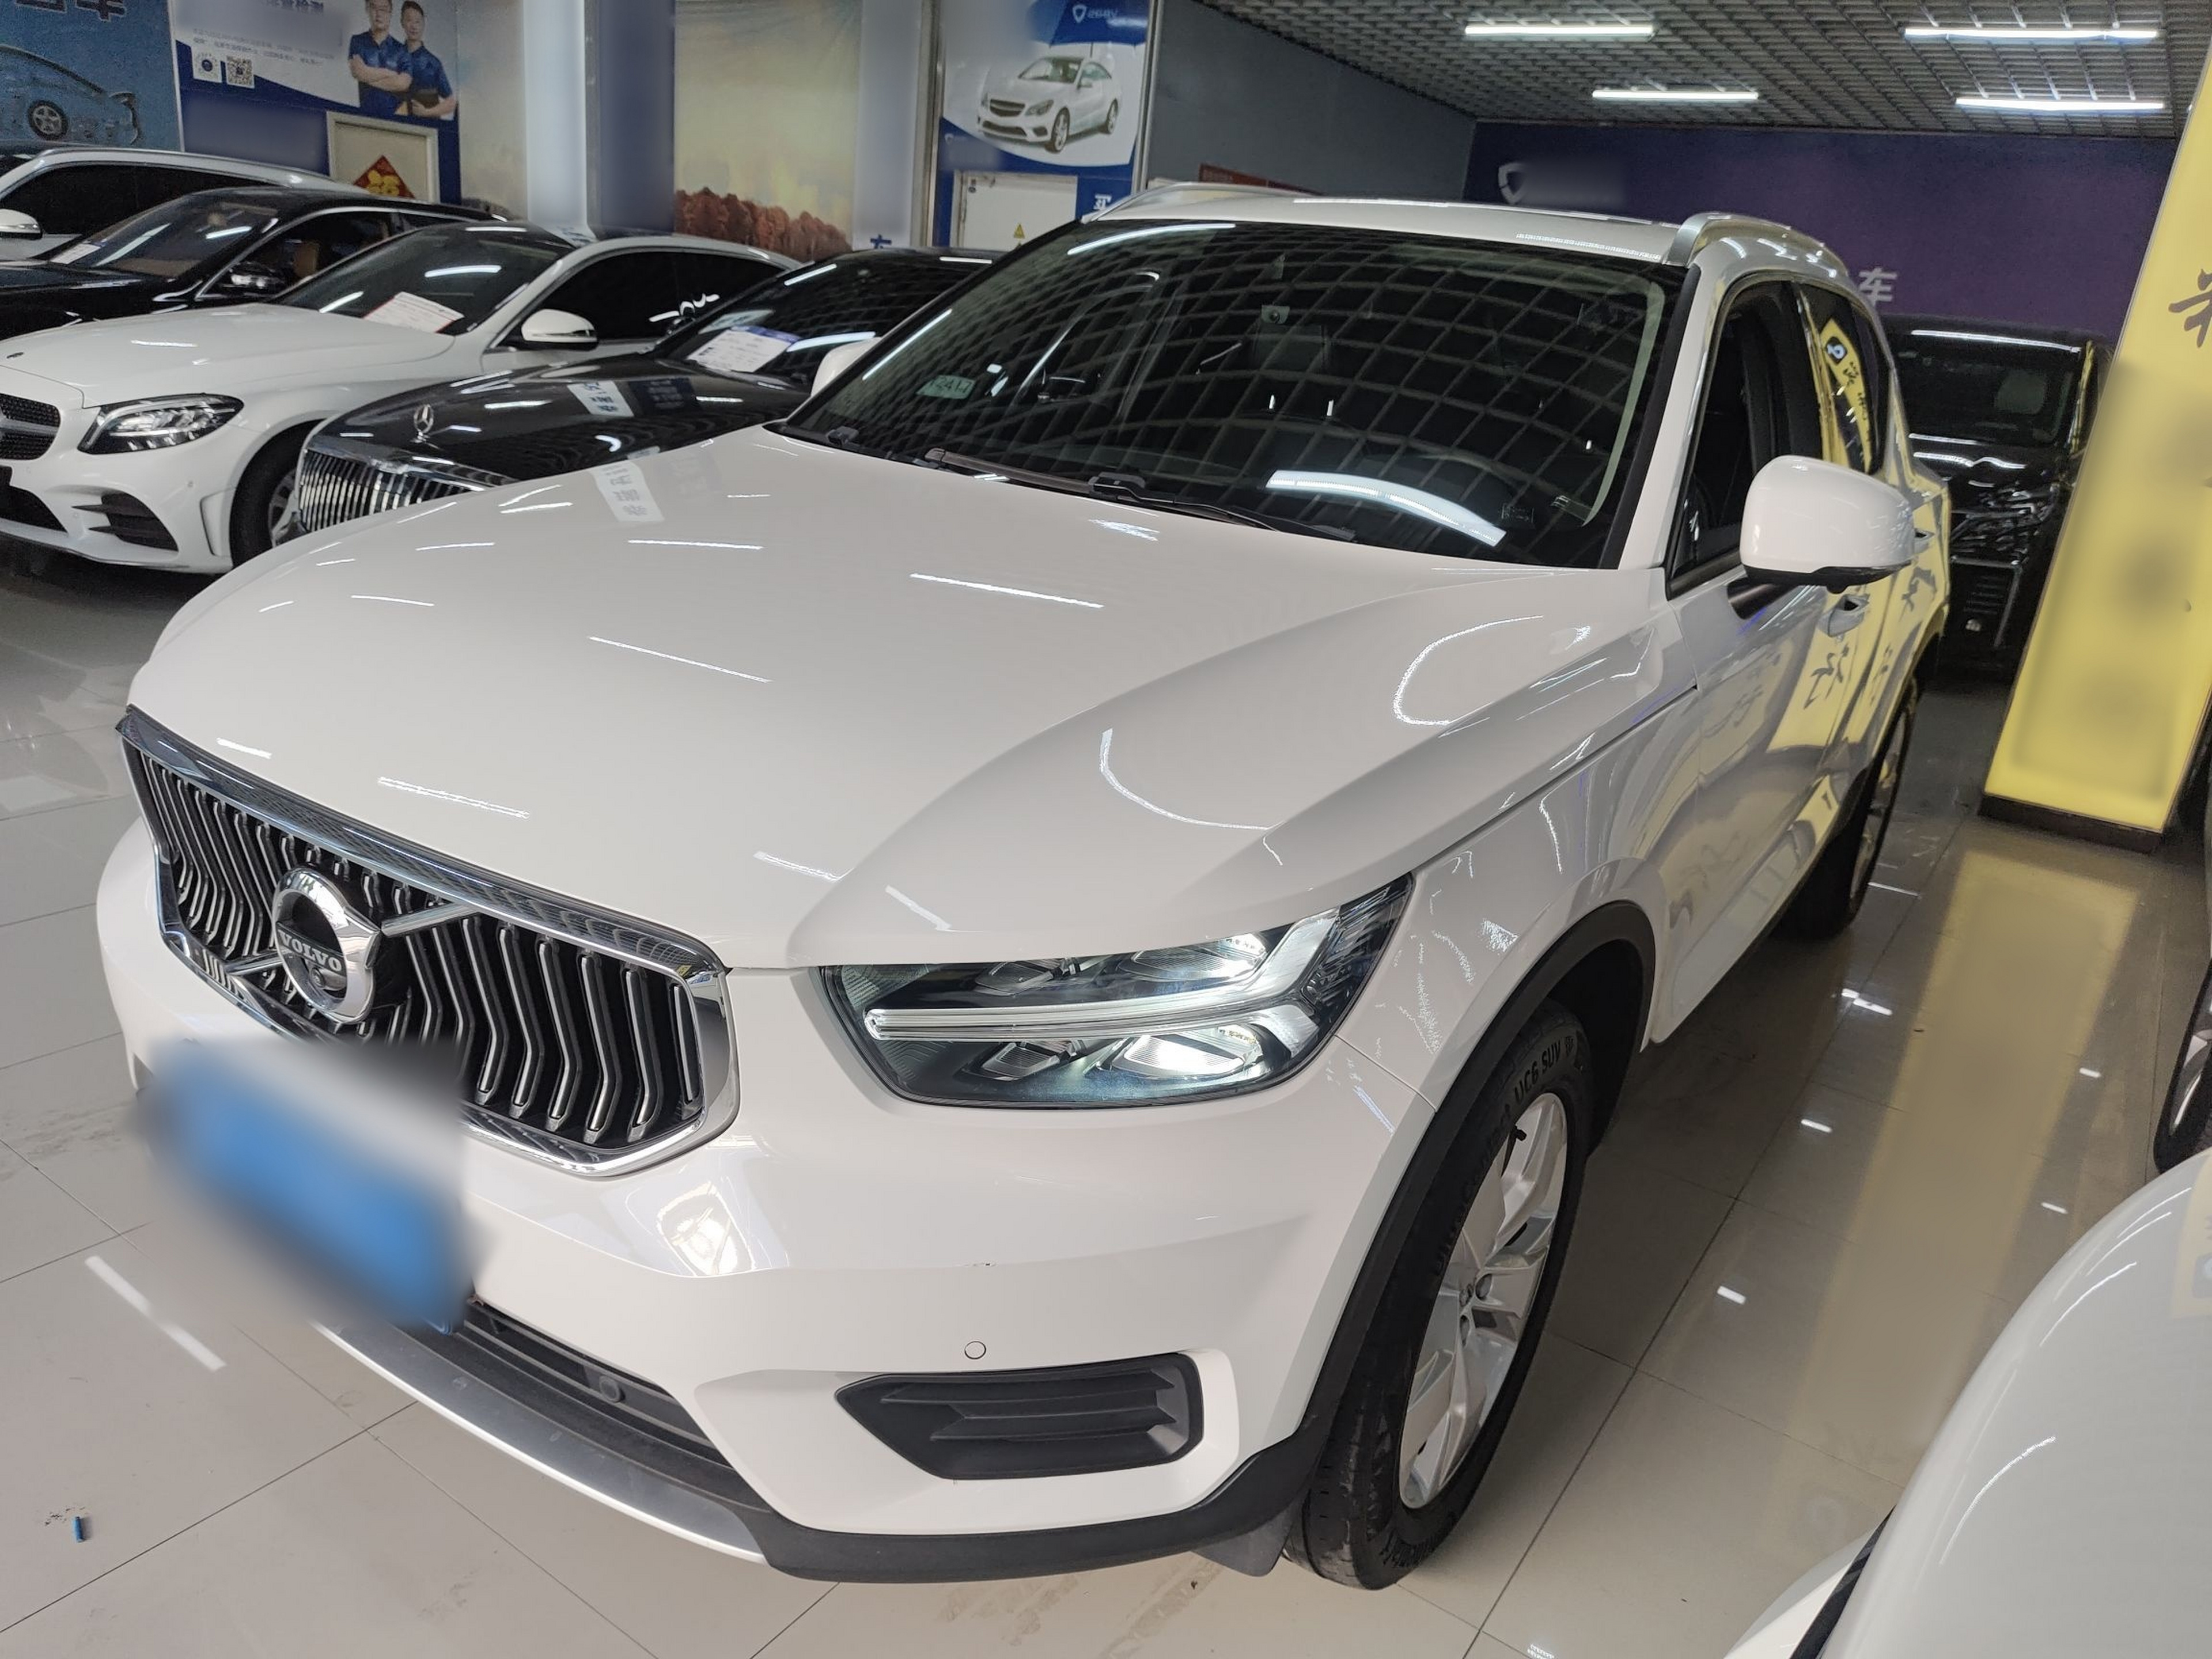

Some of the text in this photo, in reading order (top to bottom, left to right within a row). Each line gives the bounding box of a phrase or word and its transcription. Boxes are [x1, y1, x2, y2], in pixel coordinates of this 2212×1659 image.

[1858, 267, 1898, 307] 车
[277, 929, 342, 972] VOLVO
[1541, 1039, 1560, 1074] SUV
